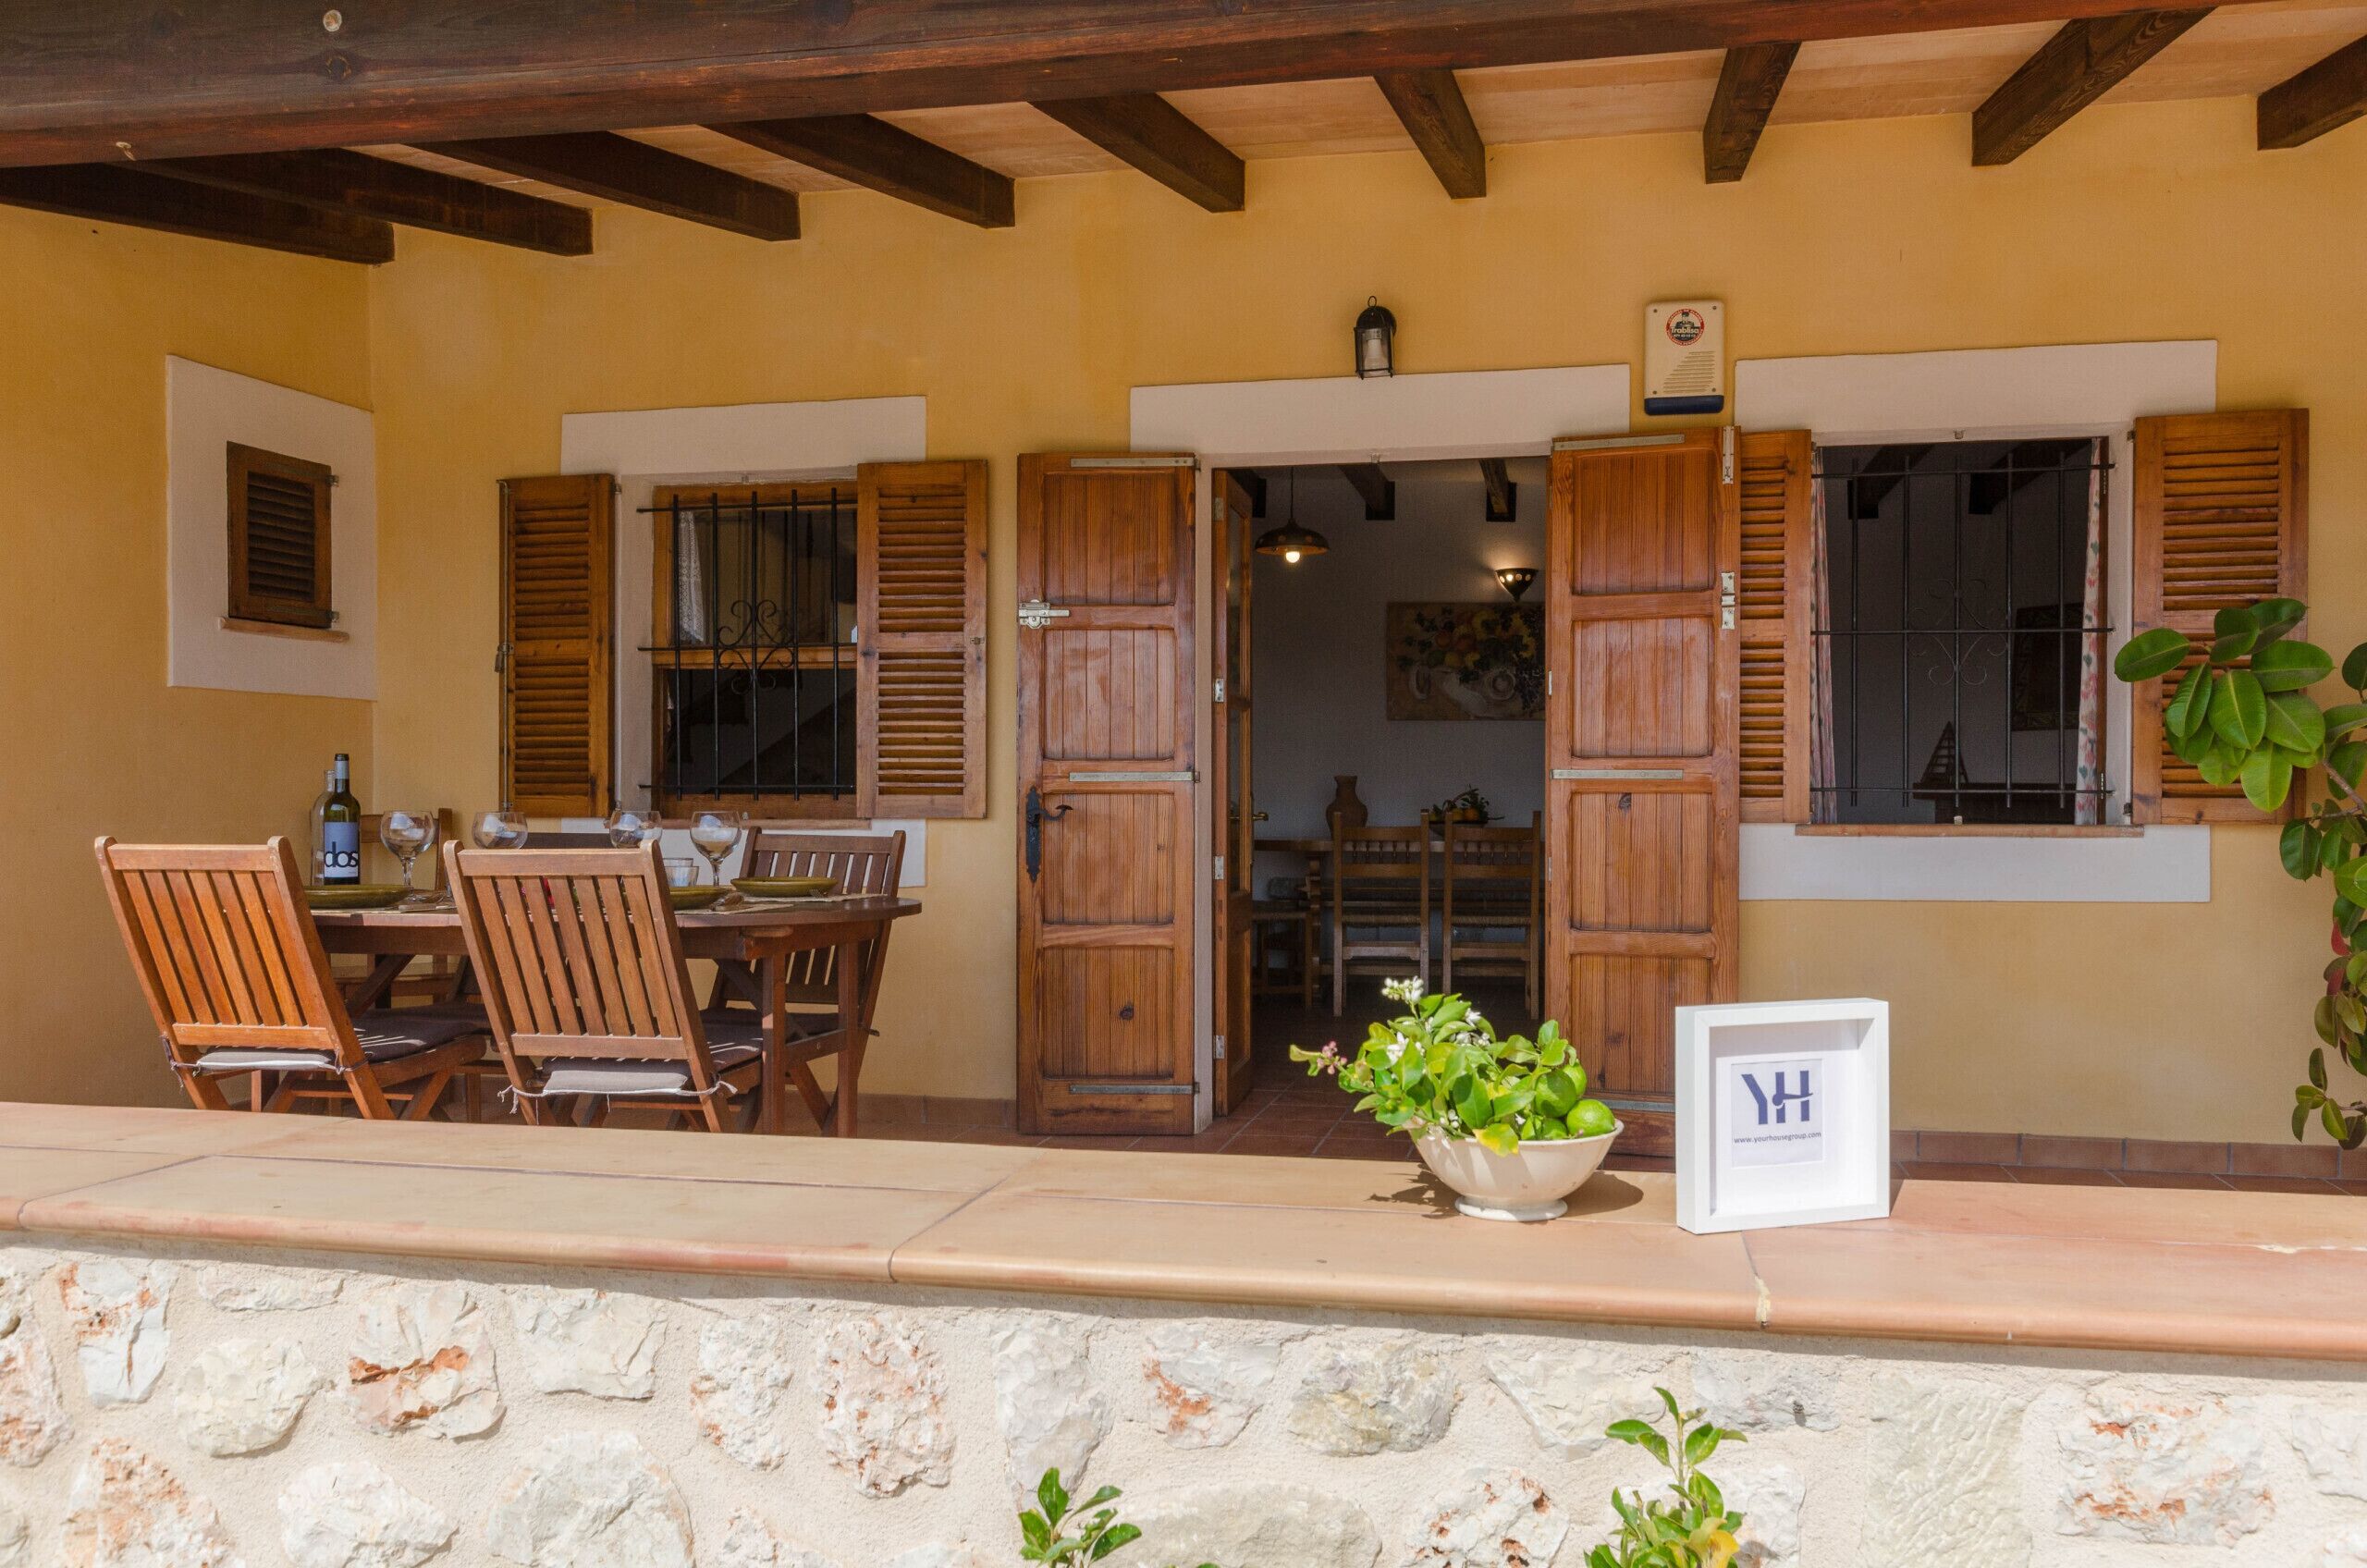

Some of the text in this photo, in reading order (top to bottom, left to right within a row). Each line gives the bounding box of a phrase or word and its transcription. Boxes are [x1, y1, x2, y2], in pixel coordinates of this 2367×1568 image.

[325, 841, 359, 868] dos
[1741, 1071, 1813, 1125] YH
[1734, 1132, 1821, 1144] www.yourhousegroup.com
